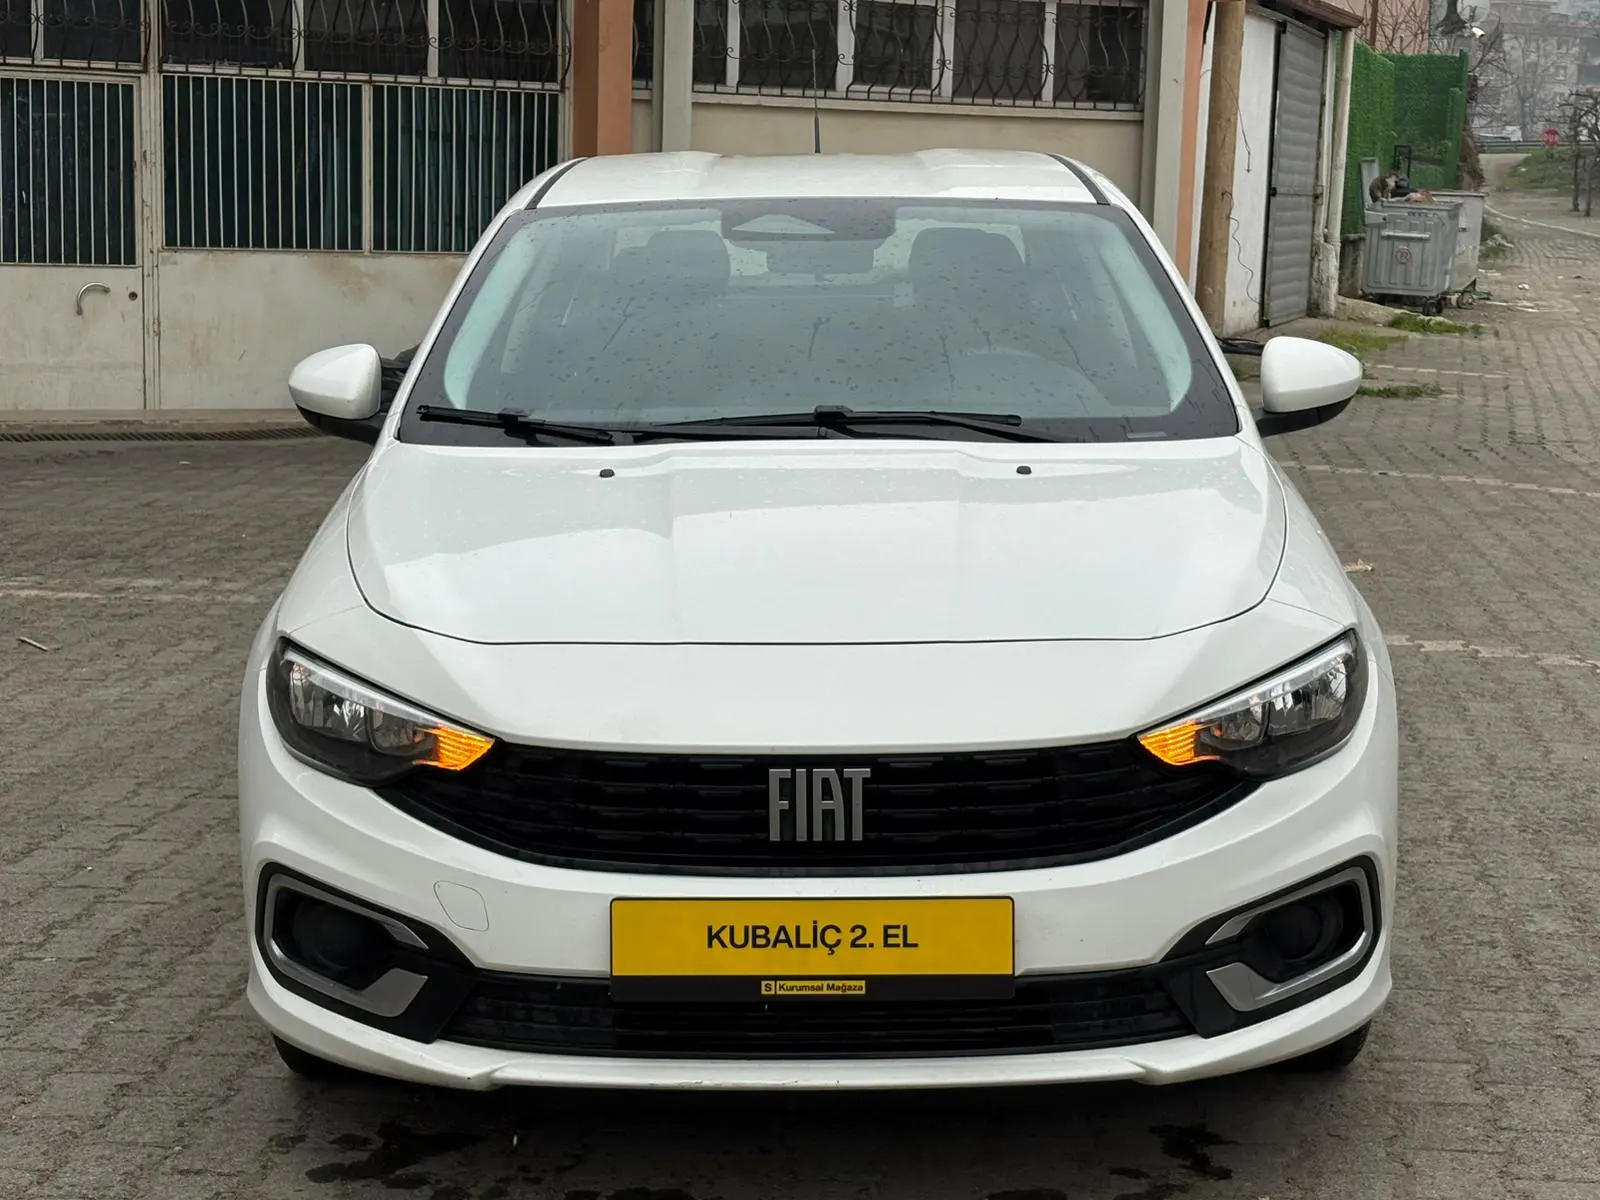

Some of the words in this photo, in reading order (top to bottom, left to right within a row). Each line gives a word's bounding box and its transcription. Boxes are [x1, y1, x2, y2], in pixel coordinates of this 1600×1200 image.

[768, 768, 871, 841] FIAT
[707, 920, 842, 955] KUBALİÇ
[850, 925, 875, 949] 2.
[883, 925, 919, 949] EL
[764, 983, 773, 993] S
[779, 983, 824, 993] Kurumsal
[827, 983, 864, 994] Mağaza
